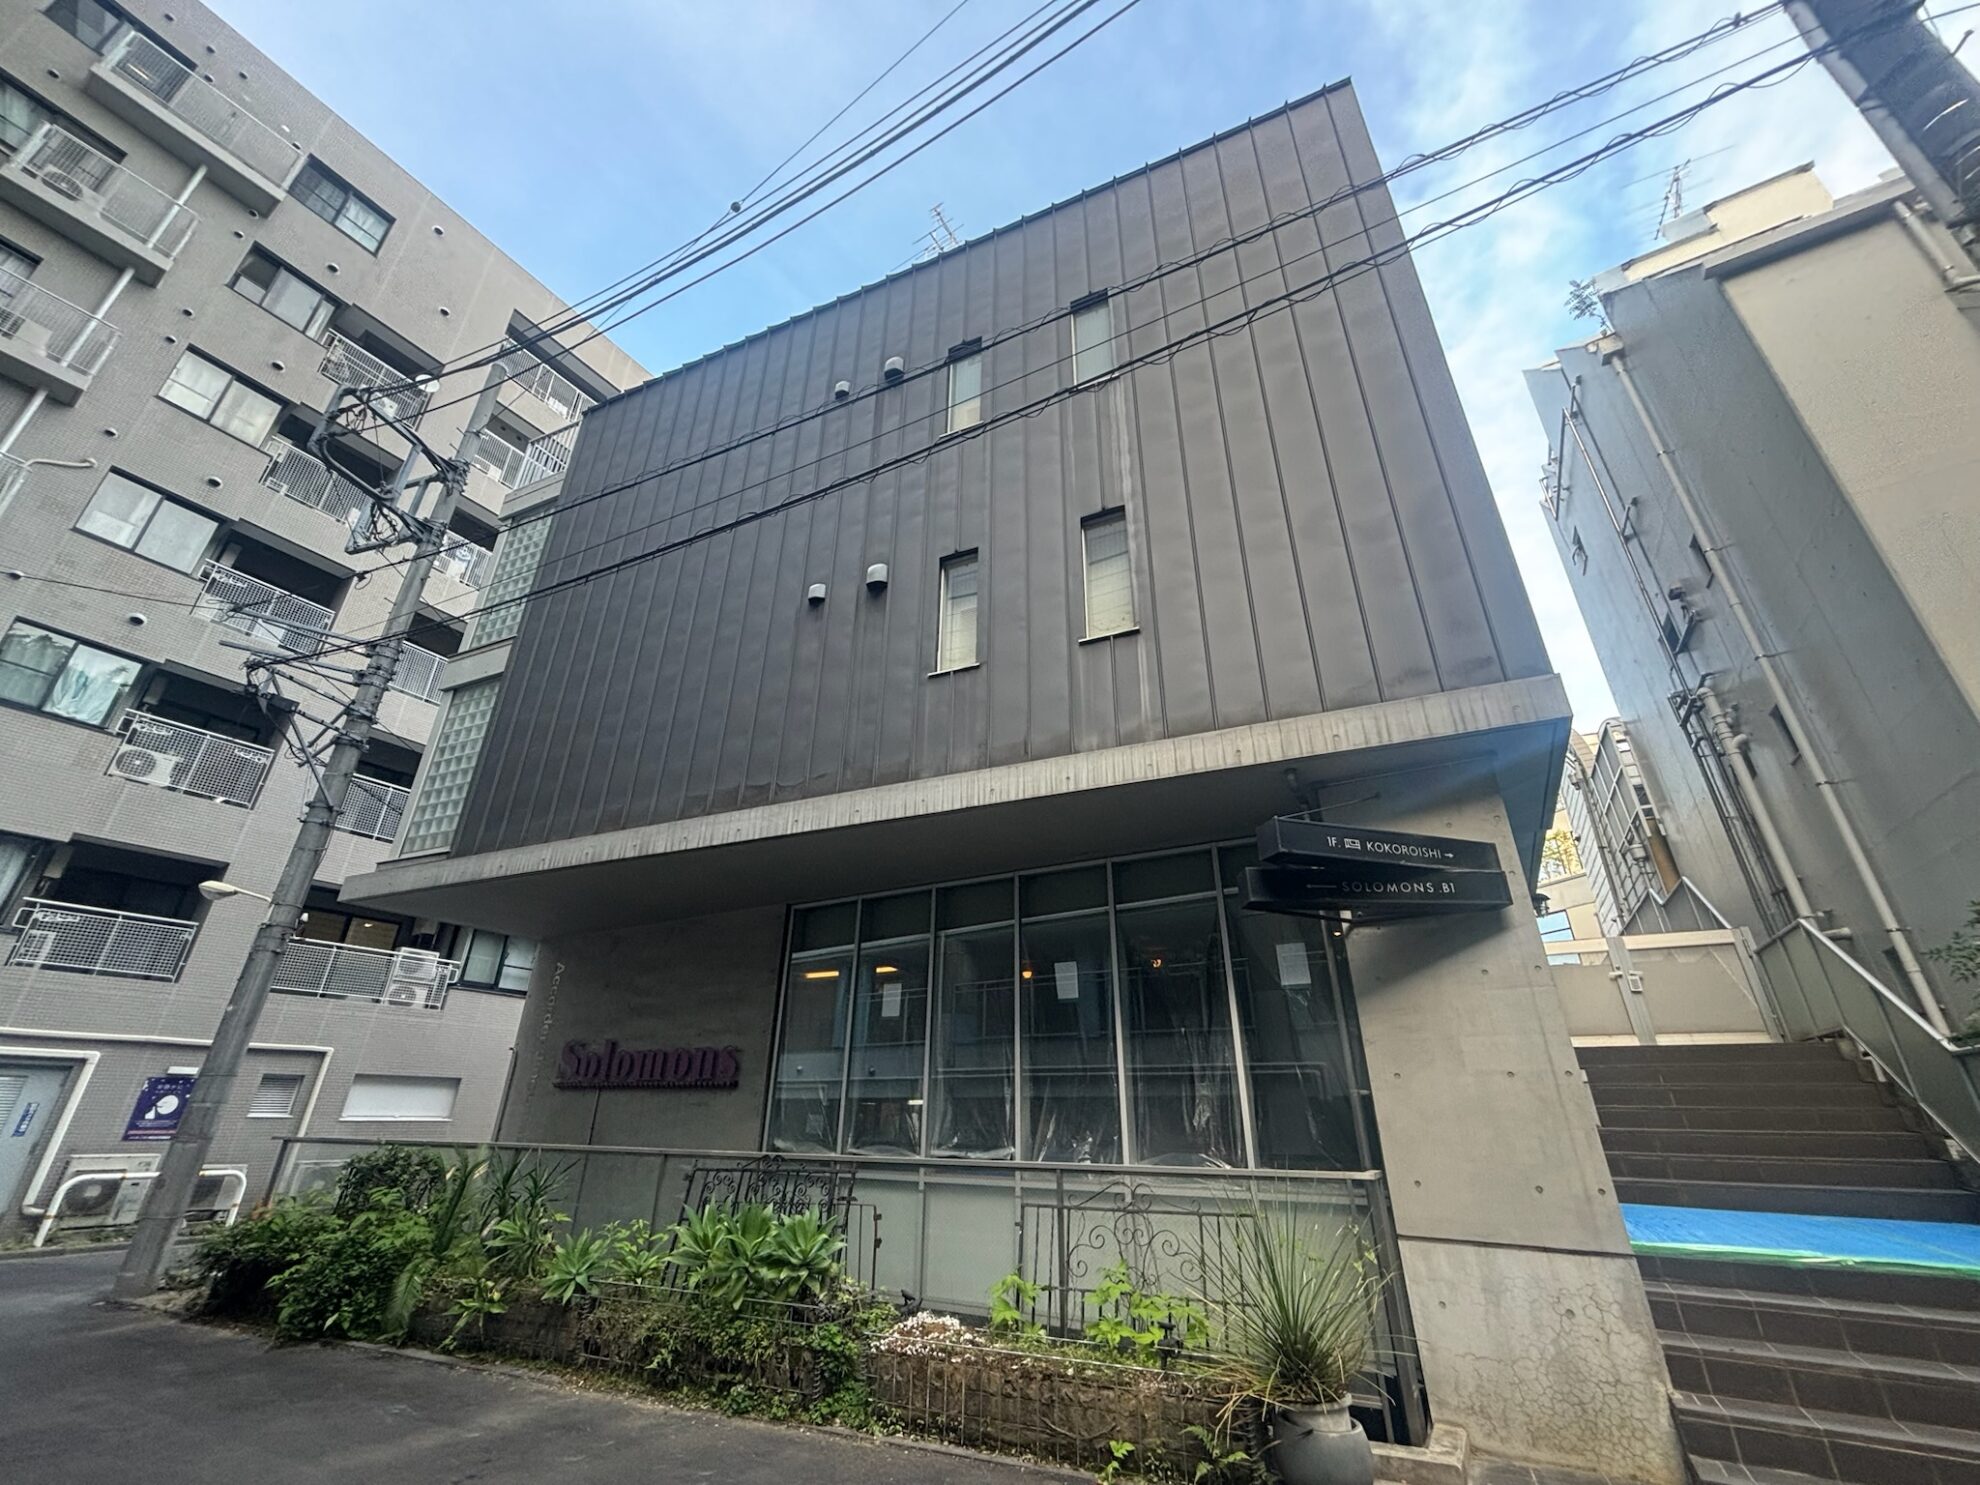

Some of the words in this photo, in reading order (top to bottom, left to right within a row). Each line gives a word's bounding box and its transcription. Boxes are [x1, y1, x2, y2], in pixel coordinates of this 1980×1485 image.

[1326, 836, 1342, 849] 1F.
[1366, 842, 1442, 859] KOKOROISHI
[1341, 881, 1434, 893] SOLOMONS
[559, 1037, 741, 1083] Solomons
